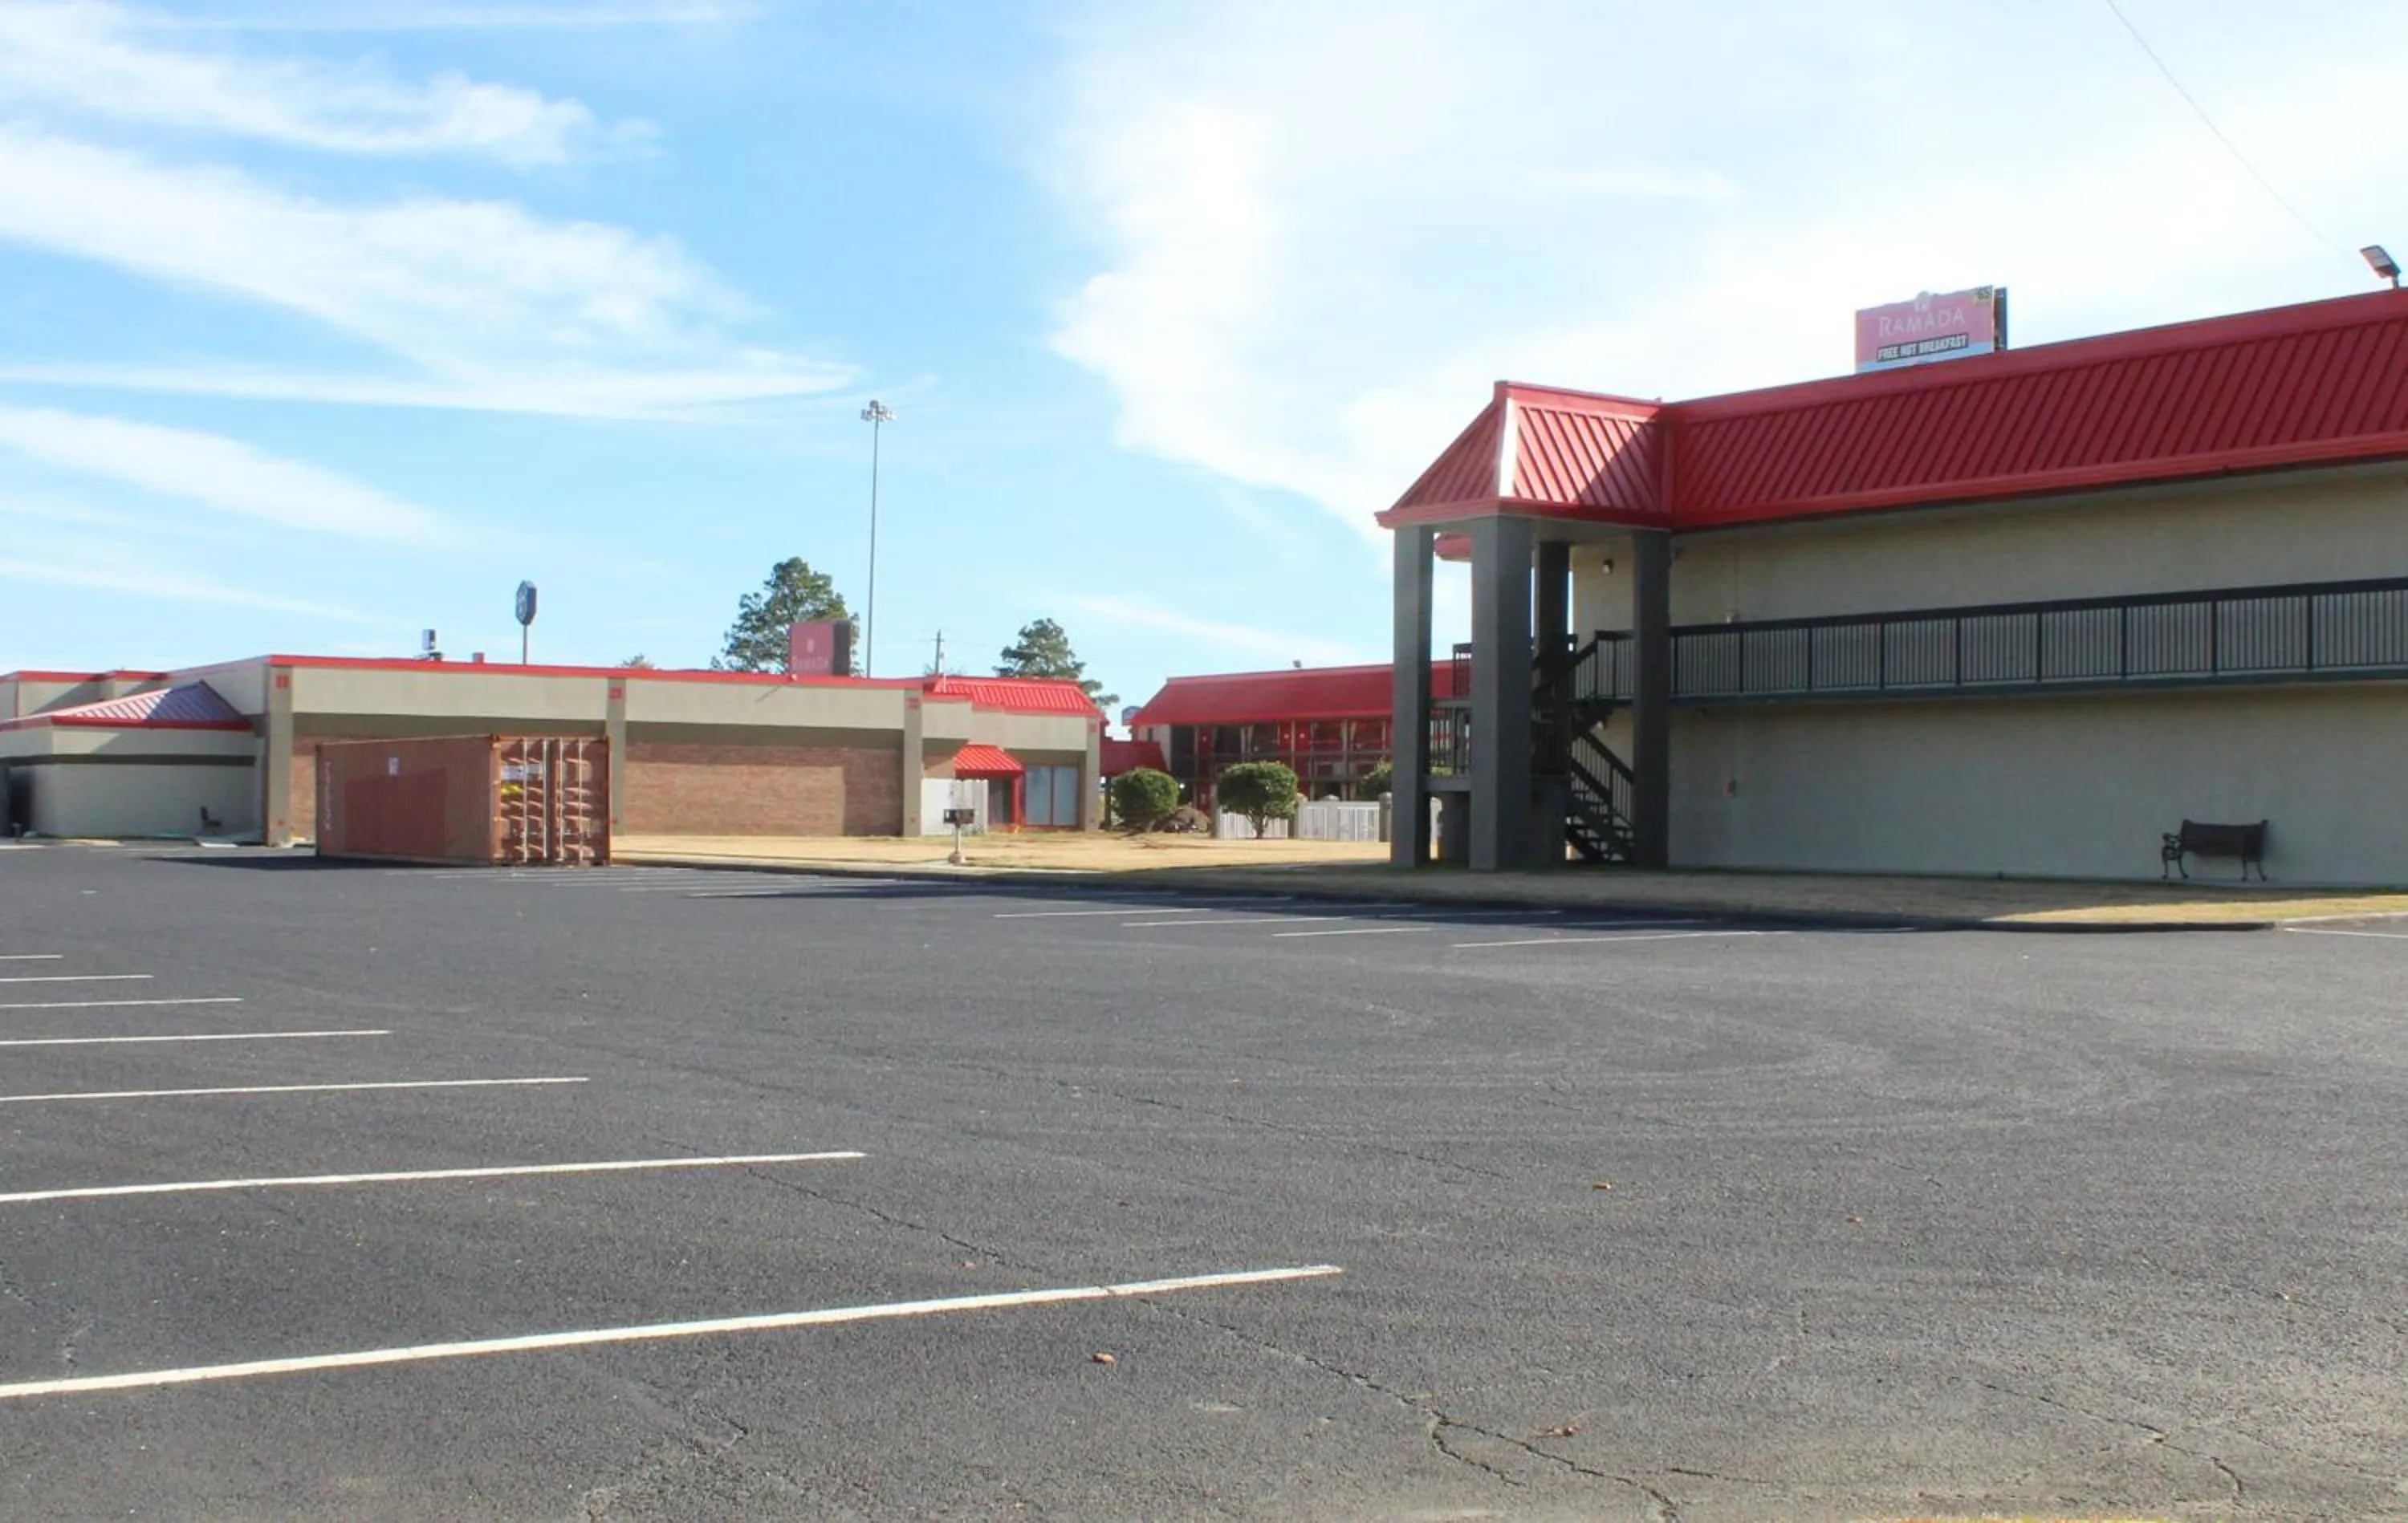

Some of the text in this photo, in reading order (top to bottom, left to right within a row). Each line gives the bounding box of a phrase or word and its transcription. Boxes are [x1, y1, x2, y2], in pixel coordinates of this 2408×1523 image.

[1879, 308, 1965, 338] RAMADA
[1878, 335, 1966, 360] FREE HOT BREAKFAST
